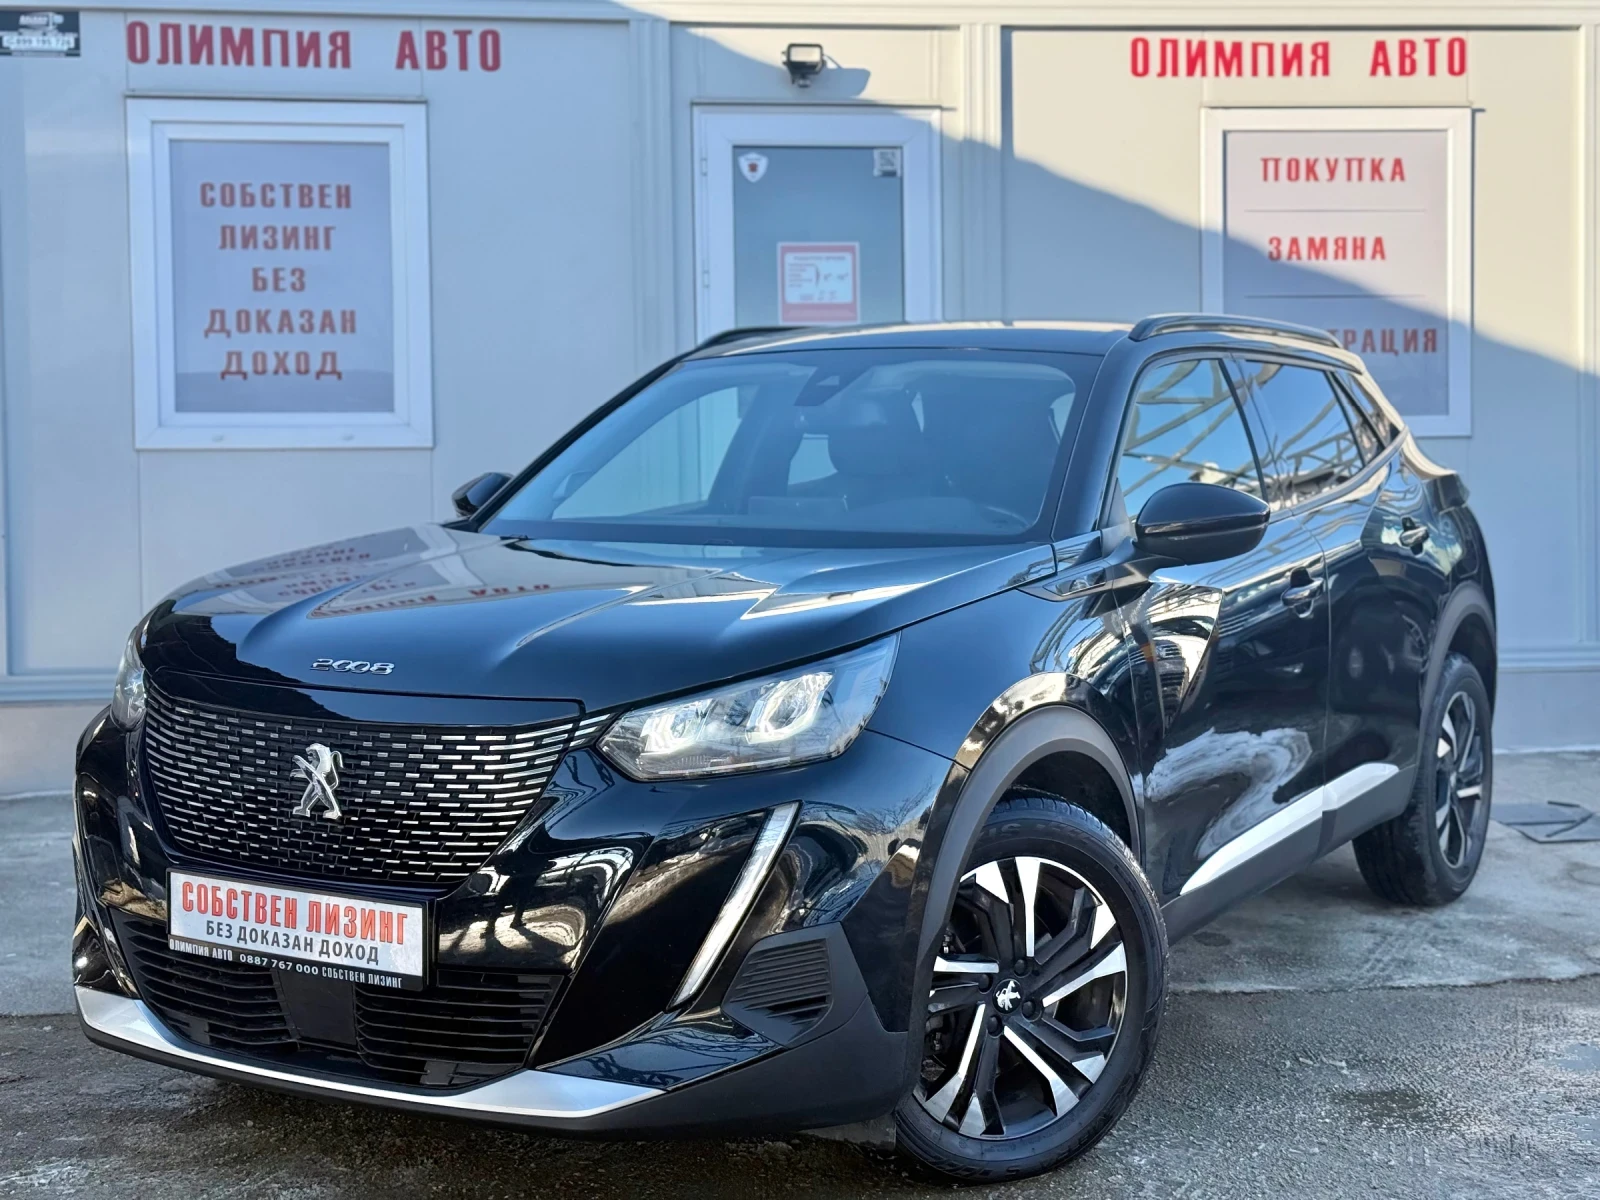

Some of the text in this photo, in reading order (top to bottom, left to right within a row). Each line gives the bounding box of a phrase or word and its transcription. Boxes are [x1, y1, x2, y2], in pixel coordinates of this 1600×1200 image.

[126, 21, 502, 72] ОЛИМПИЯ АВТО
[1130, 37, 1468, 78] ОЛИМПИЯ АВТО
[1260, 157, 1406, 183] ПОКУПКА
[200, 182, 353, 210] СОБСТВЕН
[218, 225, 335, 251] ЛИЗИНГ
[1268, 236, 1387, 261] ЗАМЯНА
[252, 268, 307, 293] БЕЗ
[204, 309, 357, 338] ДОКАЗАН
[220, 351, 343, 381] ДОХОД
[309, 658, 395, 675] 2008
[181, 881, 408, 945] СОБСТВЕН ЛИЗИНГ
[206, 920, 379, 966] БЕЗ ДОКАЗАН ДОХОД
[169, 938, 403, 988] ОЛИМПИЯ АВТО 0887 767 000 СОБСТВЕН ЛИЗИНГ
